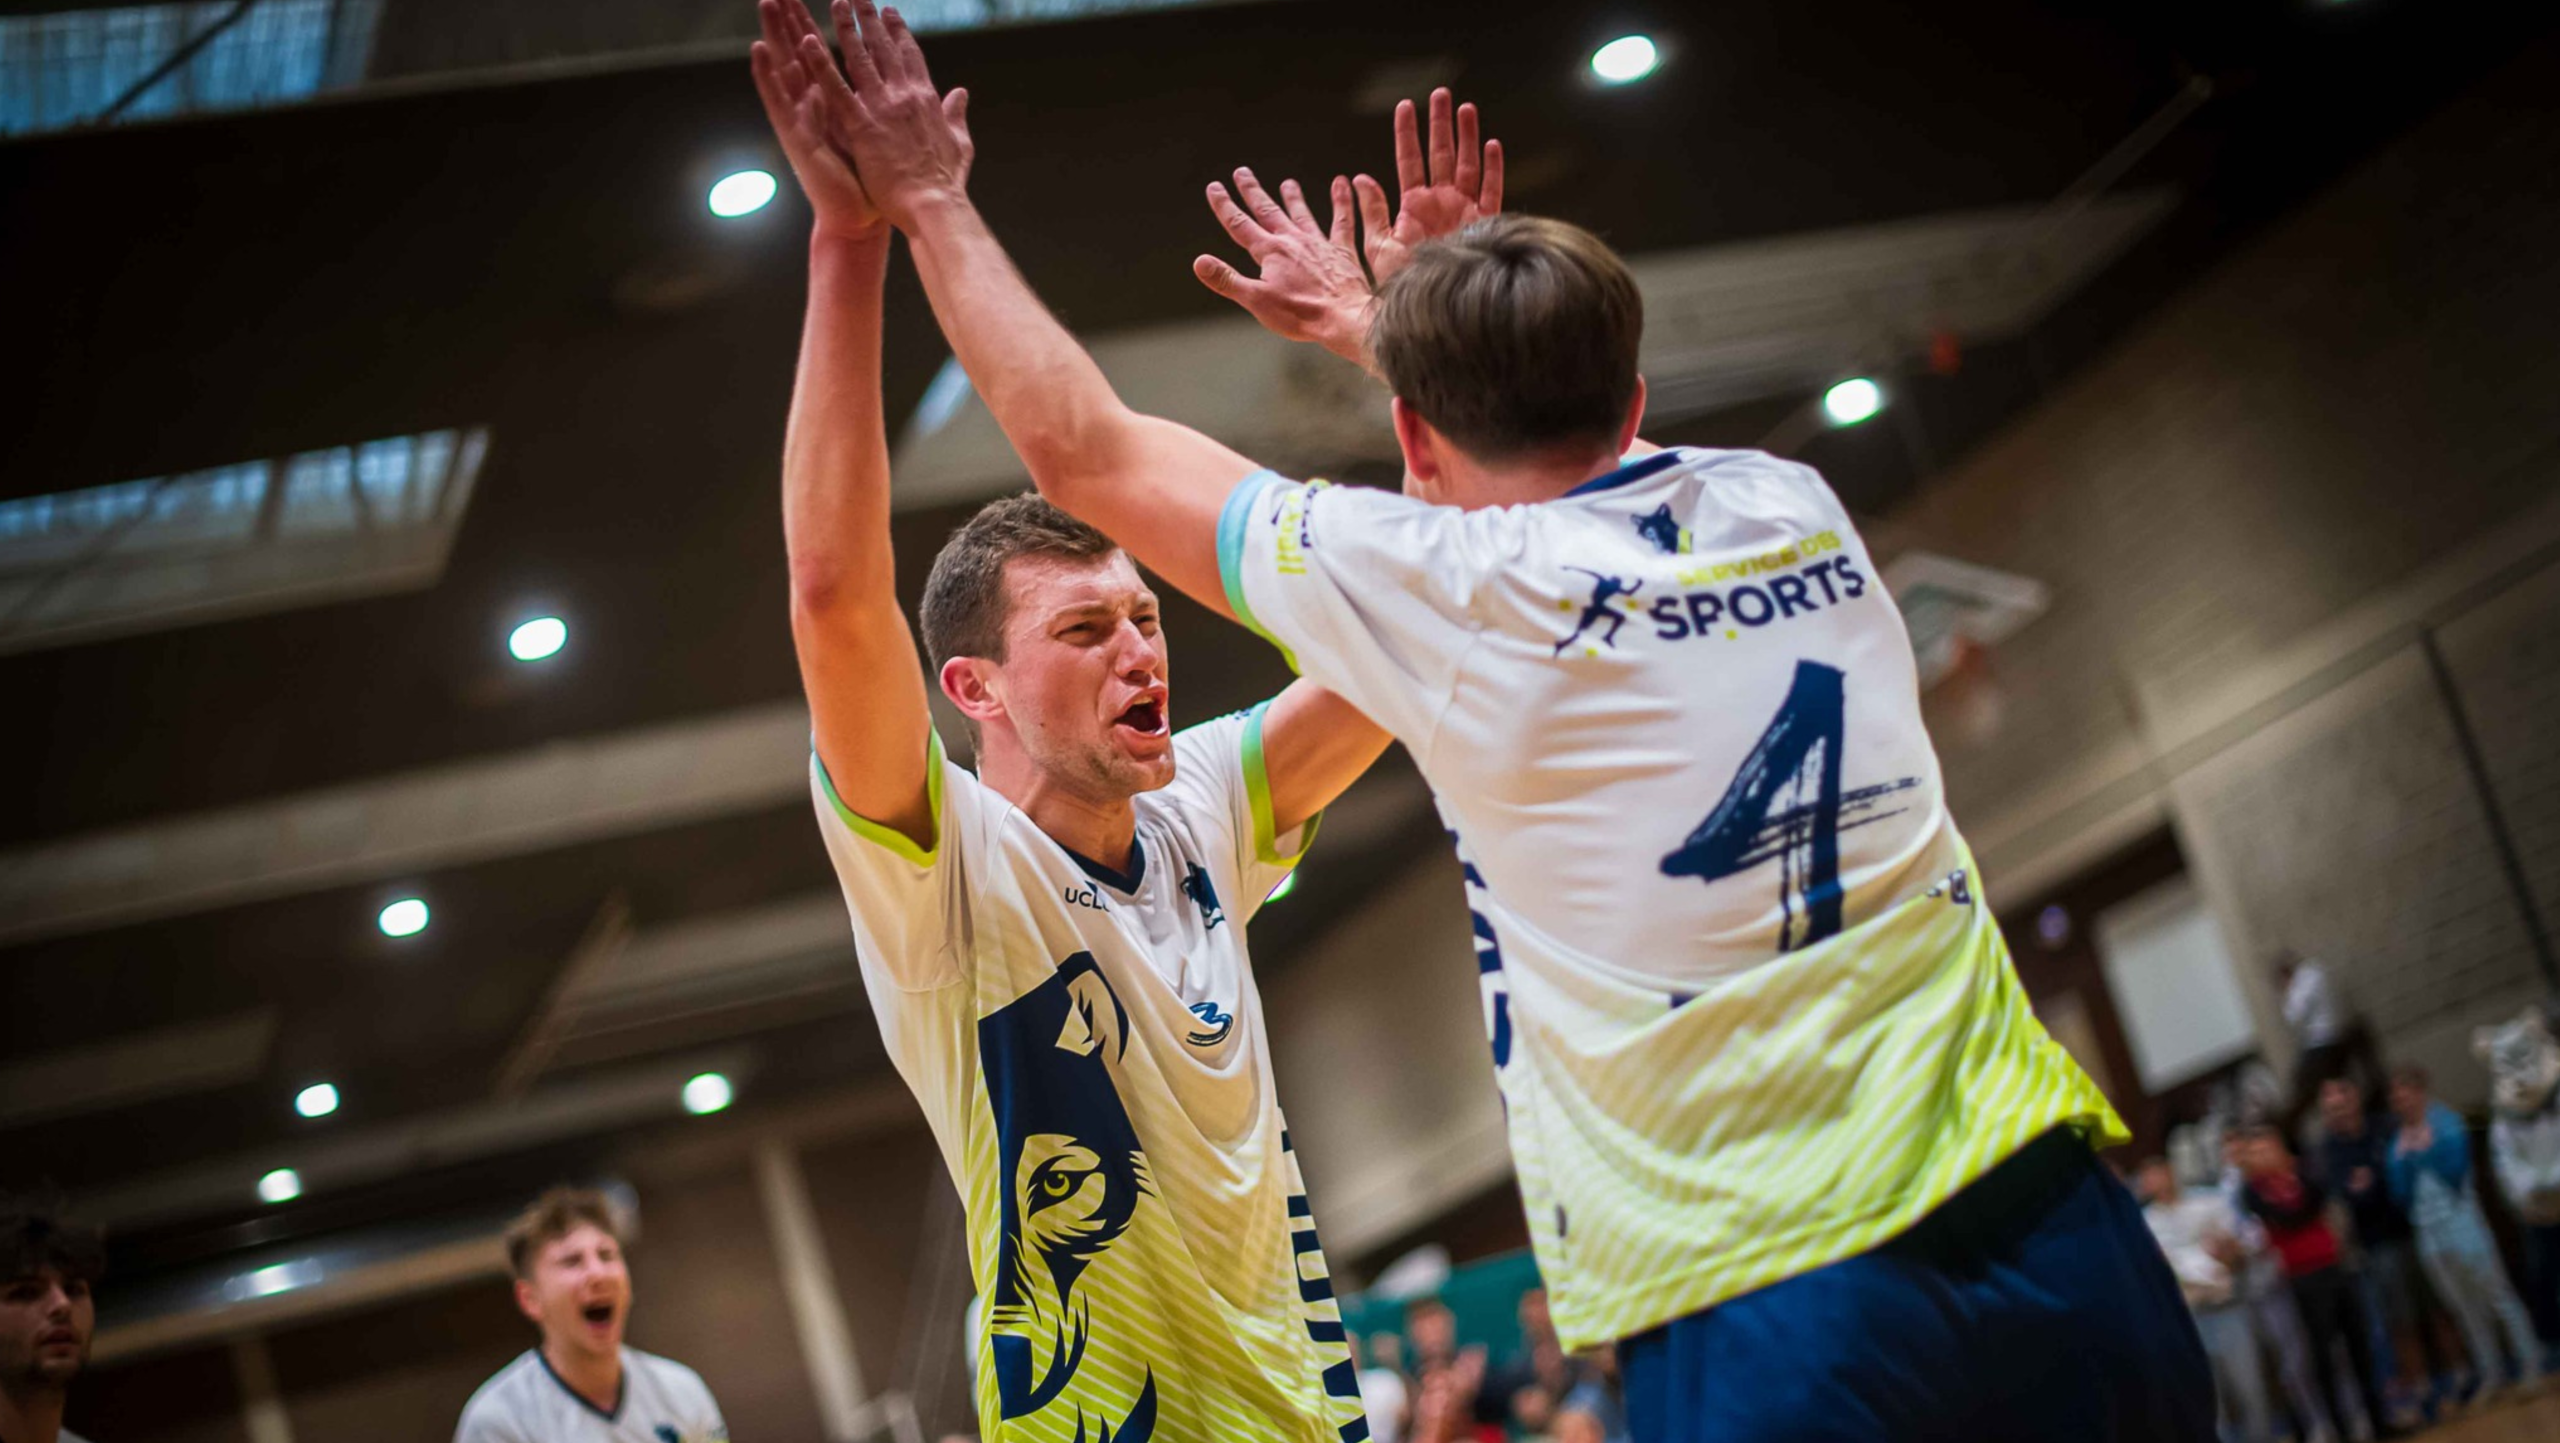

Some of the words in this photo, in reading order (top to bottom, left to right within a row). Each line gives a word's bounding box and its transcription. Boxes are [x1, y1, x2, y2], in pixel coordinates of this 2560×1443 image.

[1648, 555, 1866, 642] SPORTS
[1676, 545, 1799, 587] SERVICE
[1800, 530, 1842, 557] DES
[1659, 659, 1922, 953] 4
